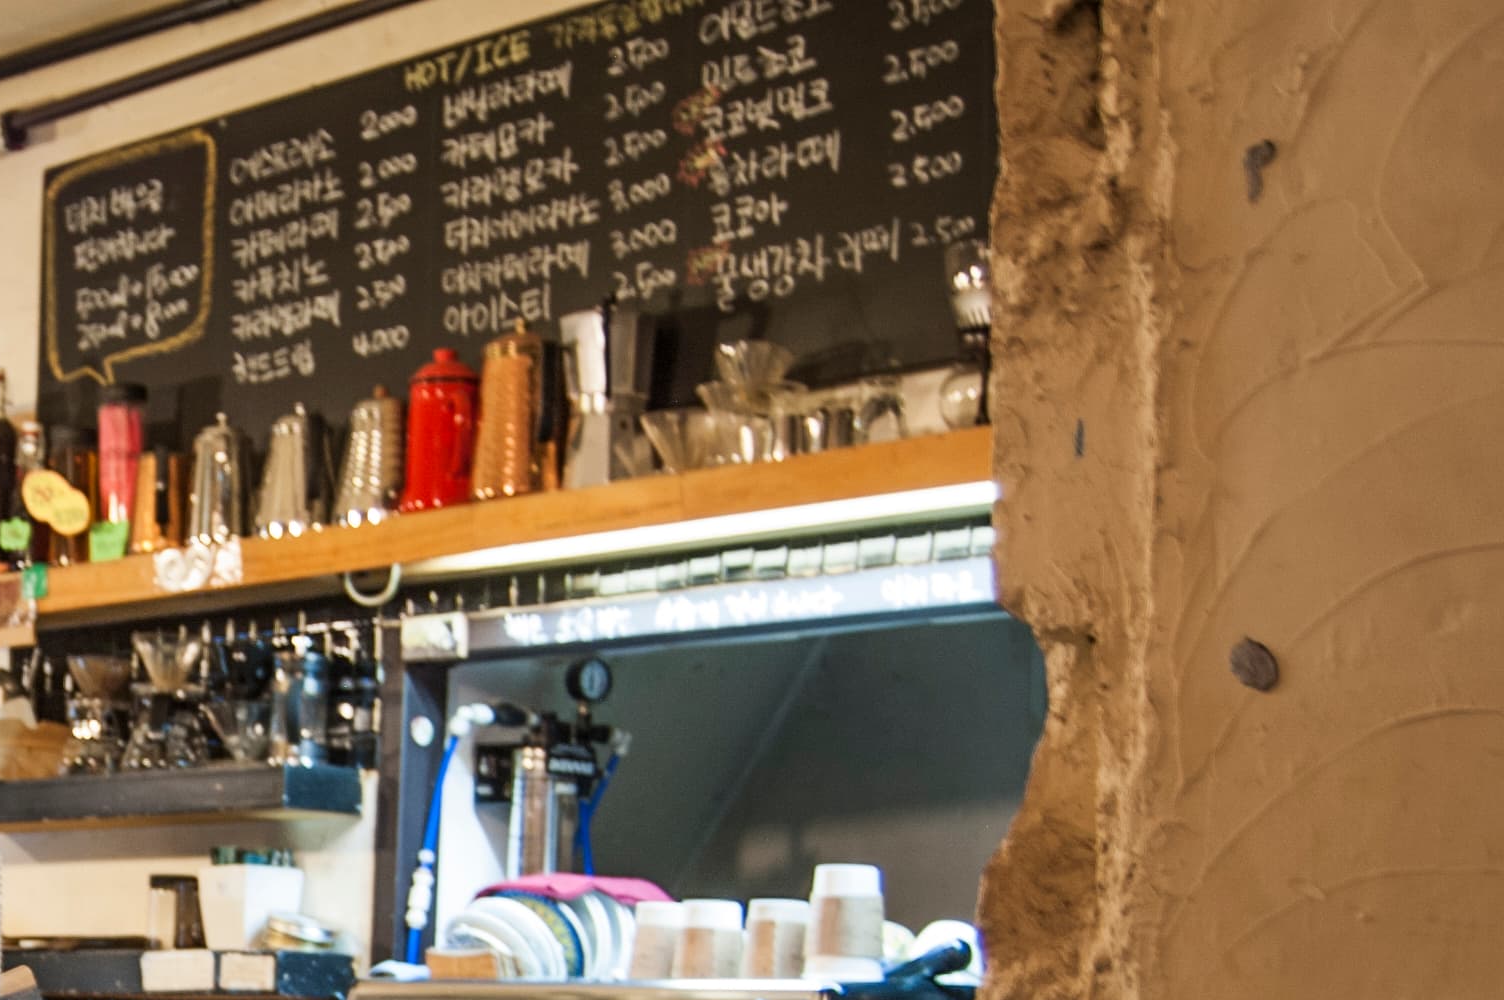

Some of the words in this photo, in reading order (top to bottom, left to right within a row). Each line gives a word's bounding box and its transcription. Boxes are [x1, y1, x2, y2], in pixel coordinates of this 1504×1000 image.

[403, 29, 532, 92] HOT/ICE
[710, 192, 789, 246] 코코아
[443, 282, 553, 336] 아이스티
